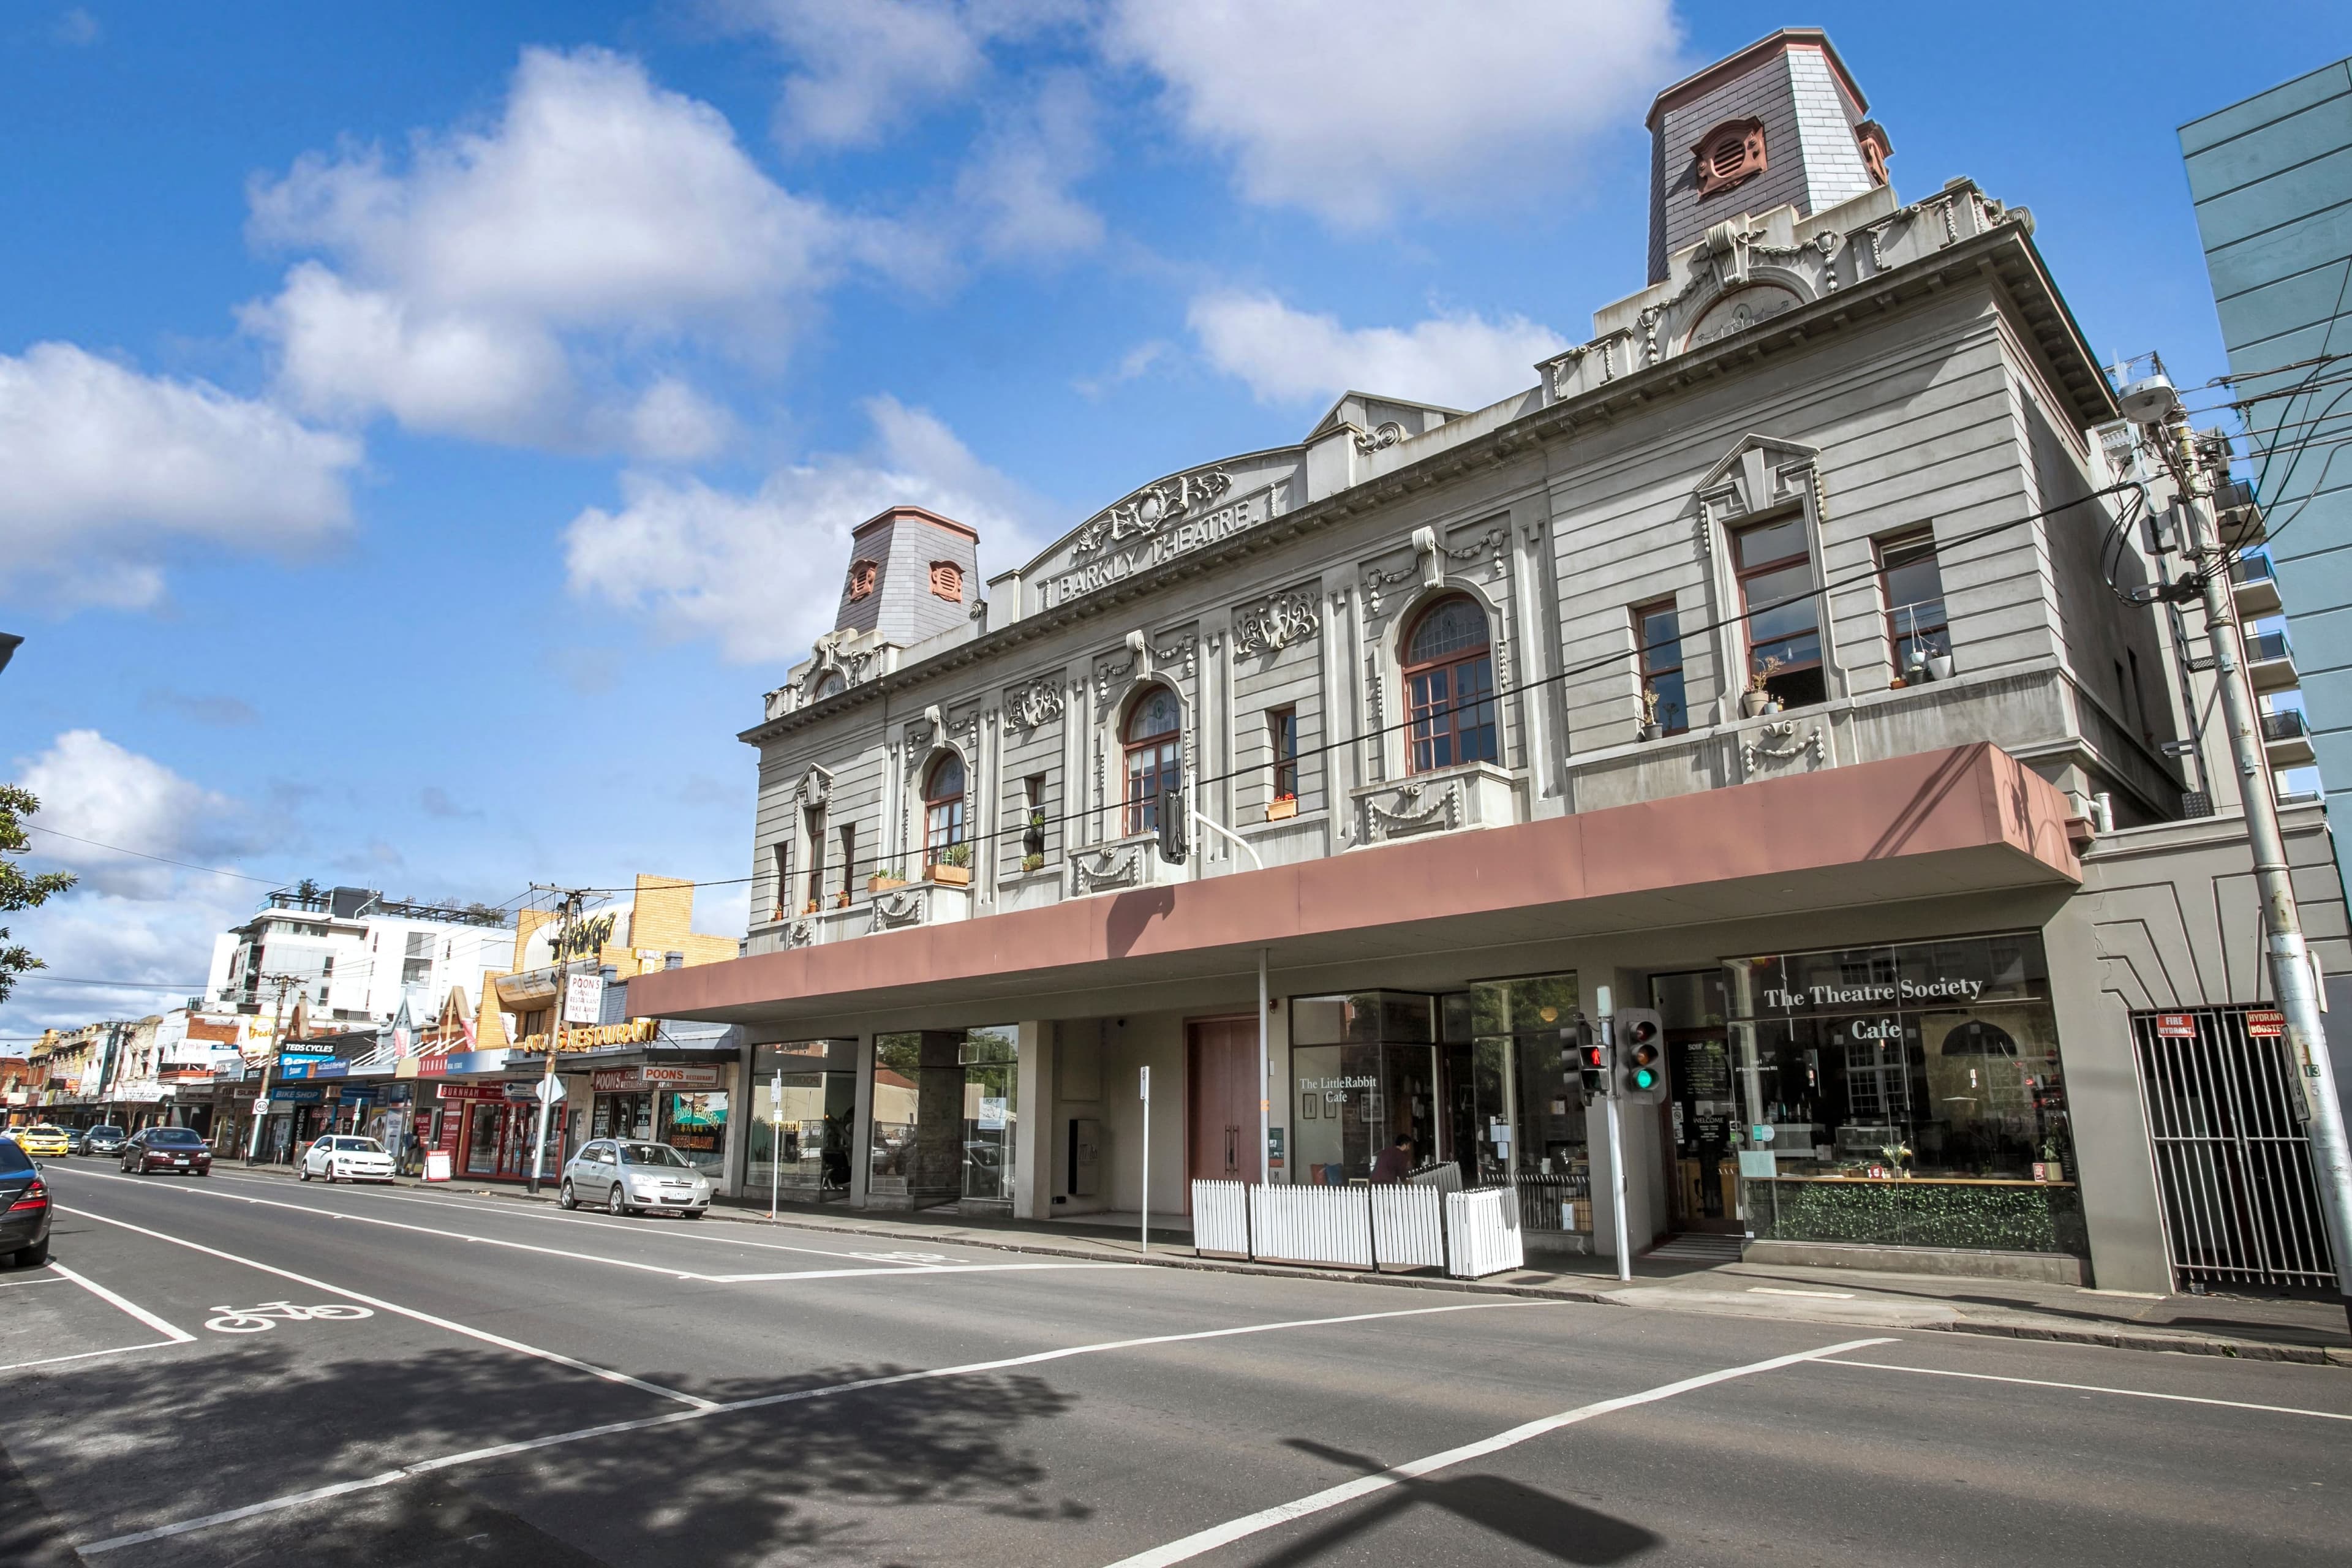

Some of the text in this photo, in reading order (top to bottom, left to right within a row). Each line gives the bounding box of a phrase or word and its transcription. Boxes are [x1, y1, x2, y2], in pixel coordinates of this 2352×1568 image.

[1059, 546, 1139, 601] BARKLY
[572, 978, 600, 990] POON'S
[1763, 976, 1983, 1008] The Theatre Society
[2165, 1016, 2184, 1025] FIRE
[2248, 1012, 2284, 1022] HYDRANT
[567, 1019, 657, 1048] RESTAURANT
[1852, 1019, 1901, 1039] Cafe
[2251, 1024, 2283, 1034] BOOSTE
[646, 1069, 684, 1079] POON'S
[595, 1072, 621, 1090] POON'S
[1299, 1078, 1317, 1089] The
[442, 1087, 479, 1097] BURNHAM
[1325, 1090, 1348, 1102] Cafe
[667, 1102, 720, 1131] POON'S CHINESE
[671, 1134, 714, 1149] RESTAURANT
